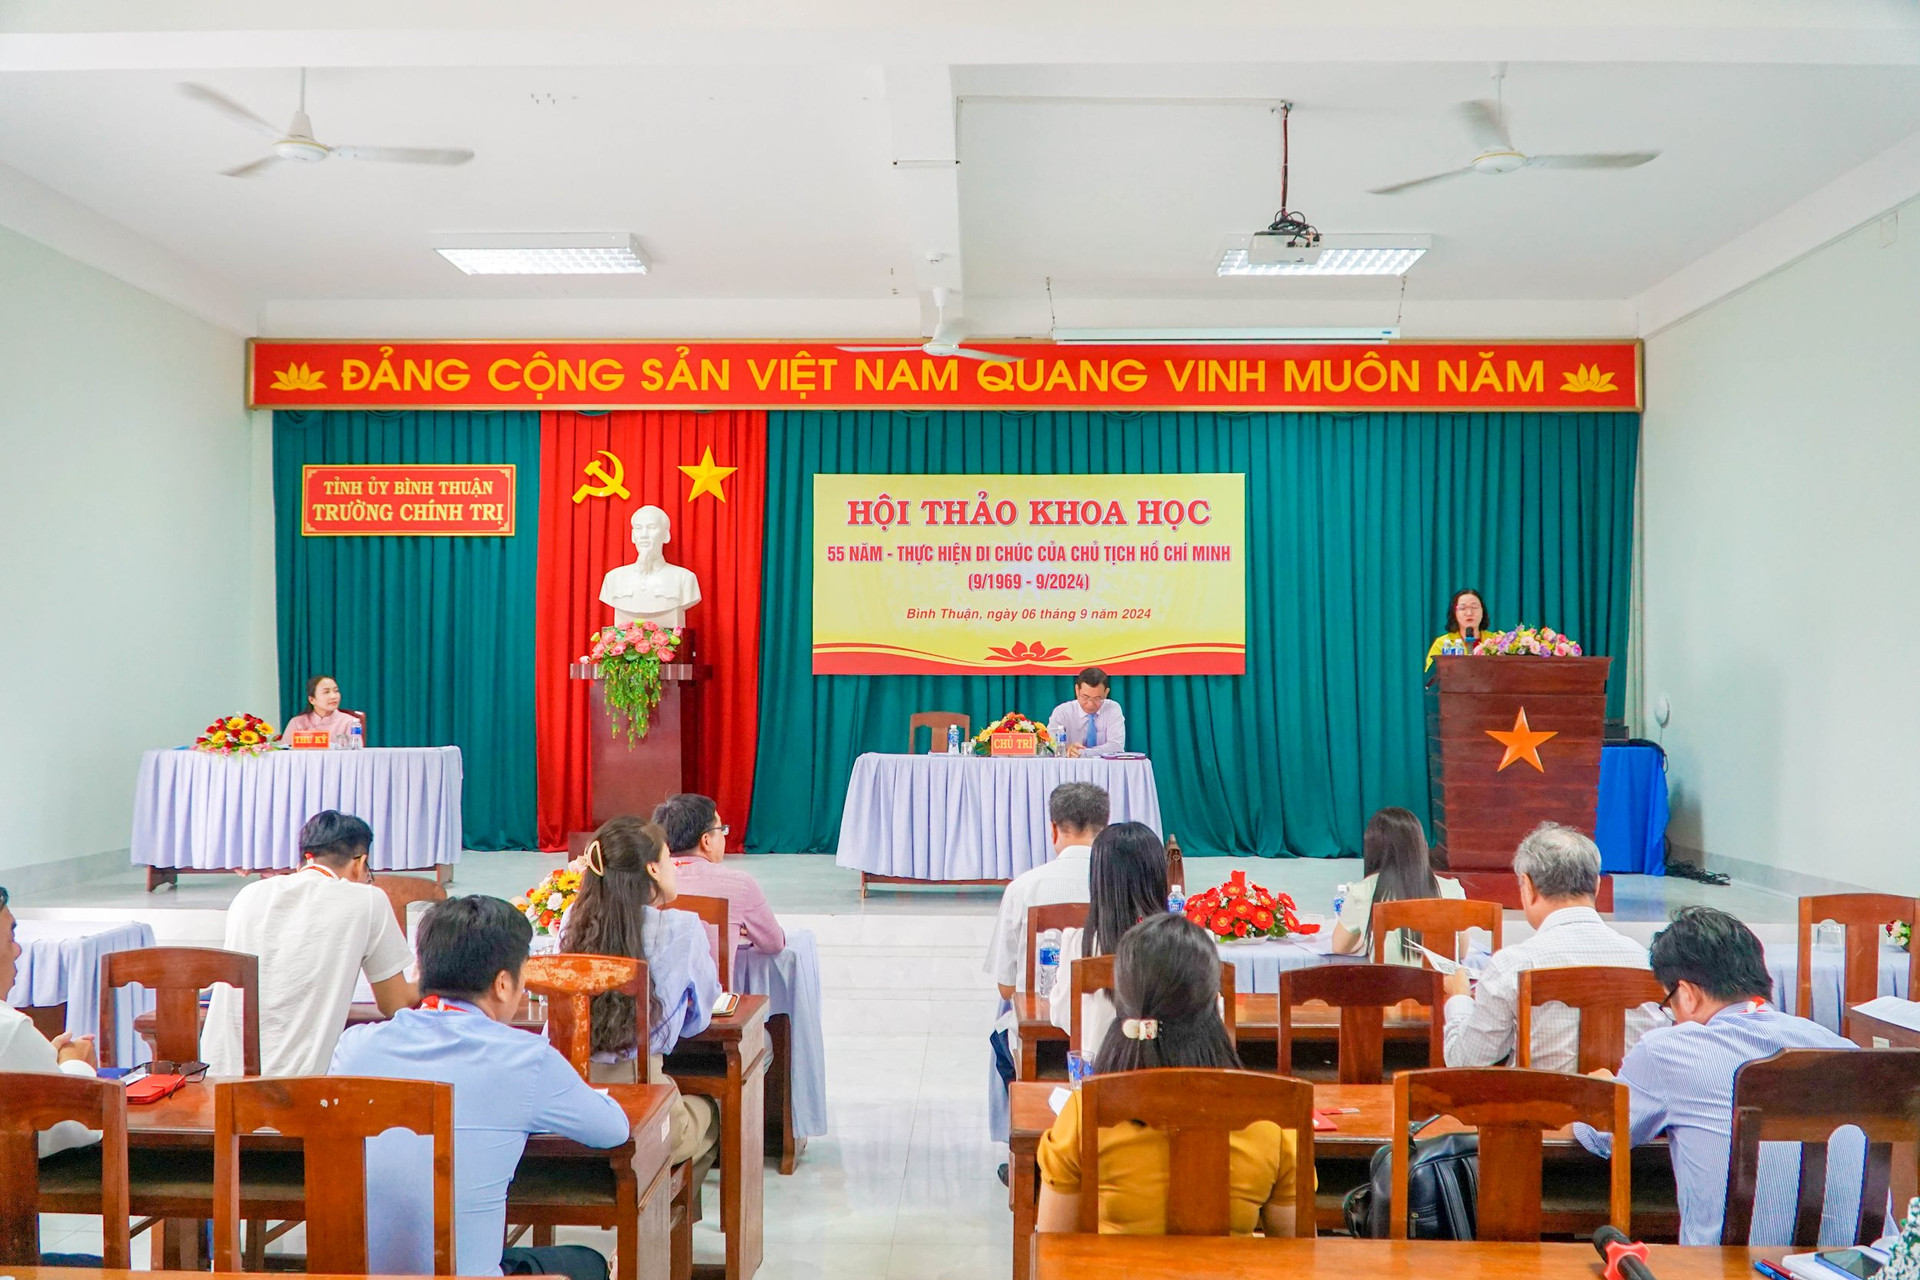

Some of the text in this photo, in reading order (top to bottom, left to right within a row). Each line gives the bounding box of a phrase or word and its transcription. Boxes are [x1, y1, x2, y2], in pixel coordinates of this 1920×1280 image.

[342, 346, 1544, 400] ĐẢNG CỘNG SẢN VIỆT NAM QUANG VINH MUÔN NĂM
[323, 476, 494, 498] TỈNH ỦY BÌNH THUẬN
[312, 499, 504, 525] TRƯỜNG CHÍNH TRỊ
[847, 490, 1211, 532] HỘI THẢO KHOA HỌC
[827, 545, 845, 562] 55
[849, 542, 883, 562] NĂM
[897, 543, 934, 566] THỰC
[938, 542, 972, 566] HIỆN
[976, 545, 990, 562] DI
[994, 543, 1033, 562] CHÚC
[1037, 540, 1067, 562] CỦA
[1070, 540, 1100, 562] CHỦ
[1103, 545, 1136, 566] TỊCH
[1163, 542, 1188, 562] CHÍ
[1192, 545, 1231, 562] MINH
[968, 573, 1022, 591] (9/1969
[1035, 573, 1090, 591] 9/2024)
[906, 607, 1152, 624] Bình Thuận, ngày 06 tháng 9 năm 2024
[993, 735, 1033, 749] CHỦ TRÌ
